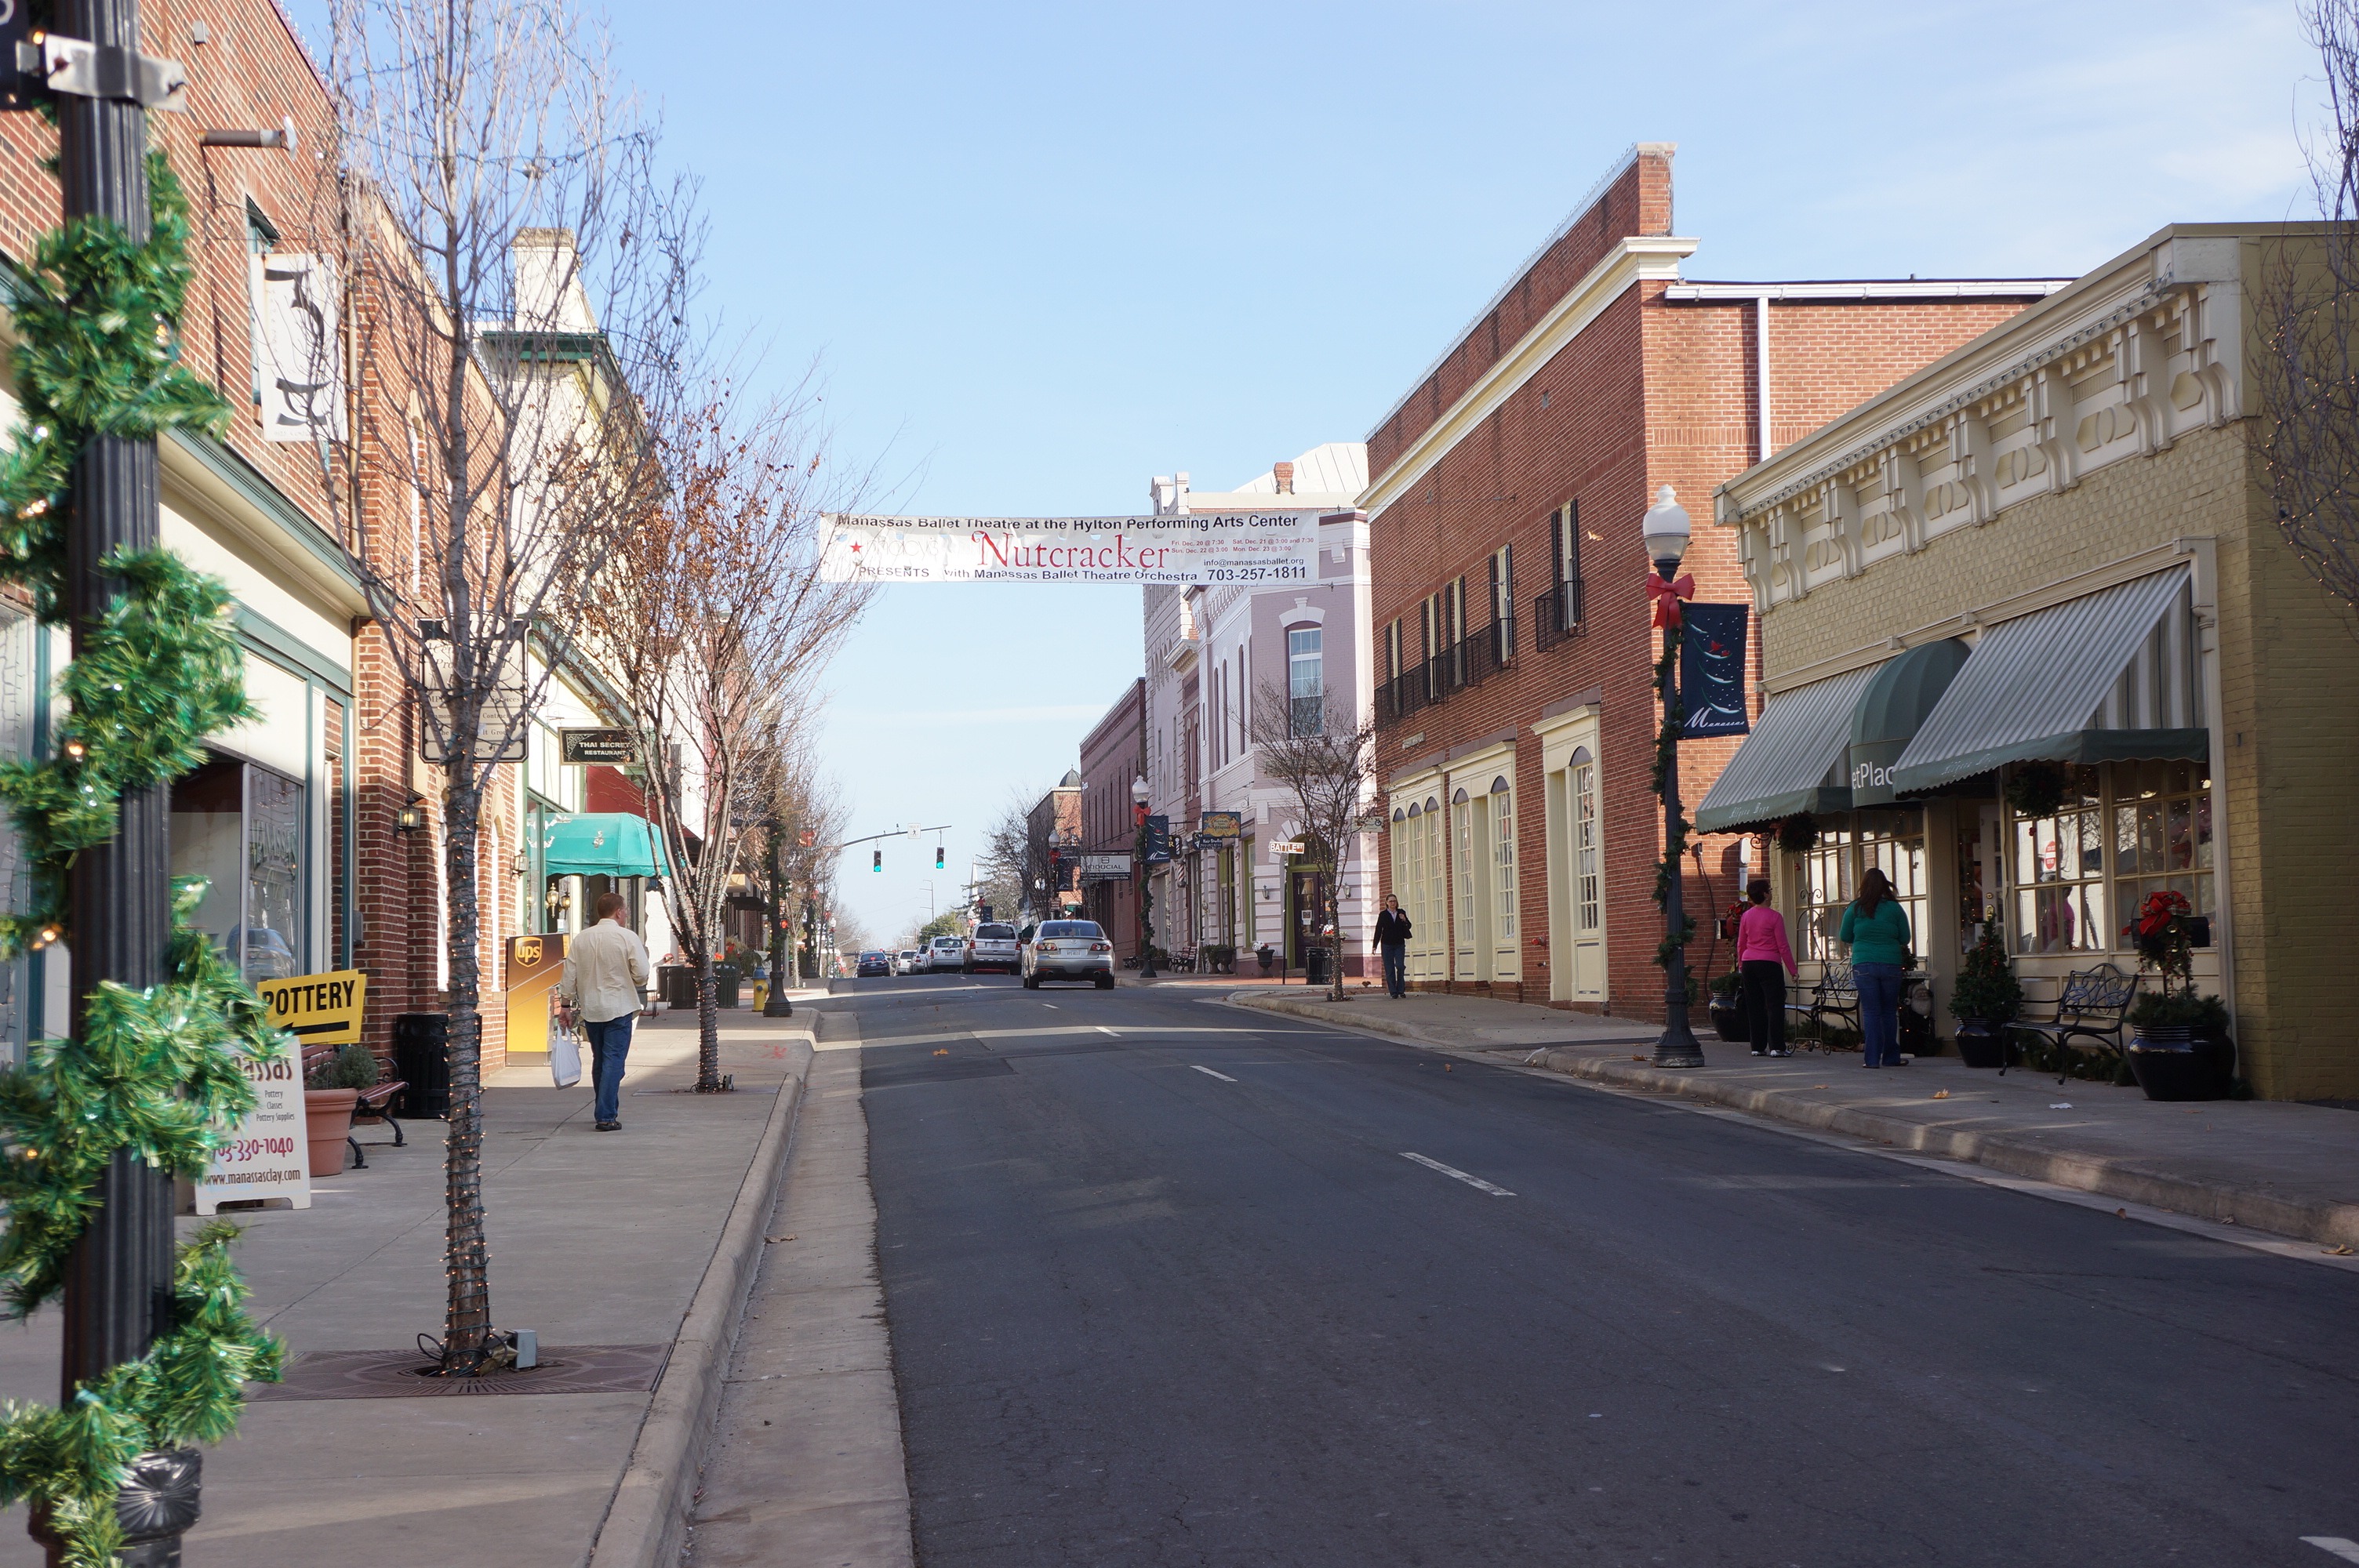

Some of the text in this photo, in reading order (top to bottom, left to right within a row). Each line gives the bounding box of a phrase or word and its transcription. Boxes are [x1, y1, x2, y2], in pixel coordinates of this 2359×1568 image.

[837, 514, 1299, 533] Manassas Ballet Theatre at the Hylton Performing Arts Center
[971, 530, 1170, 568] Nutcracker
[1204, 557, 1304, 567] info@manassasballet.org
[859, 566, 929, 577] PRESENTS
[944, 569, 1198, 581] with Manassas Ballet Theatre Orchestra
[1207, 566, 1307, 581] 703-257-1811
[1684, 706, 1745, 728] Manassas
[1270, 844, 1296, 852] BATTLE
[517, 946, 540, 963] ups
[262, 980, 355, 1016] POTTERY
[264, 1090, 283, 1099] Pottery
[256, 1112, 295, 1123] Pottery Supplies
[205, 1167, 301, 1185] www.manassasclay.com
